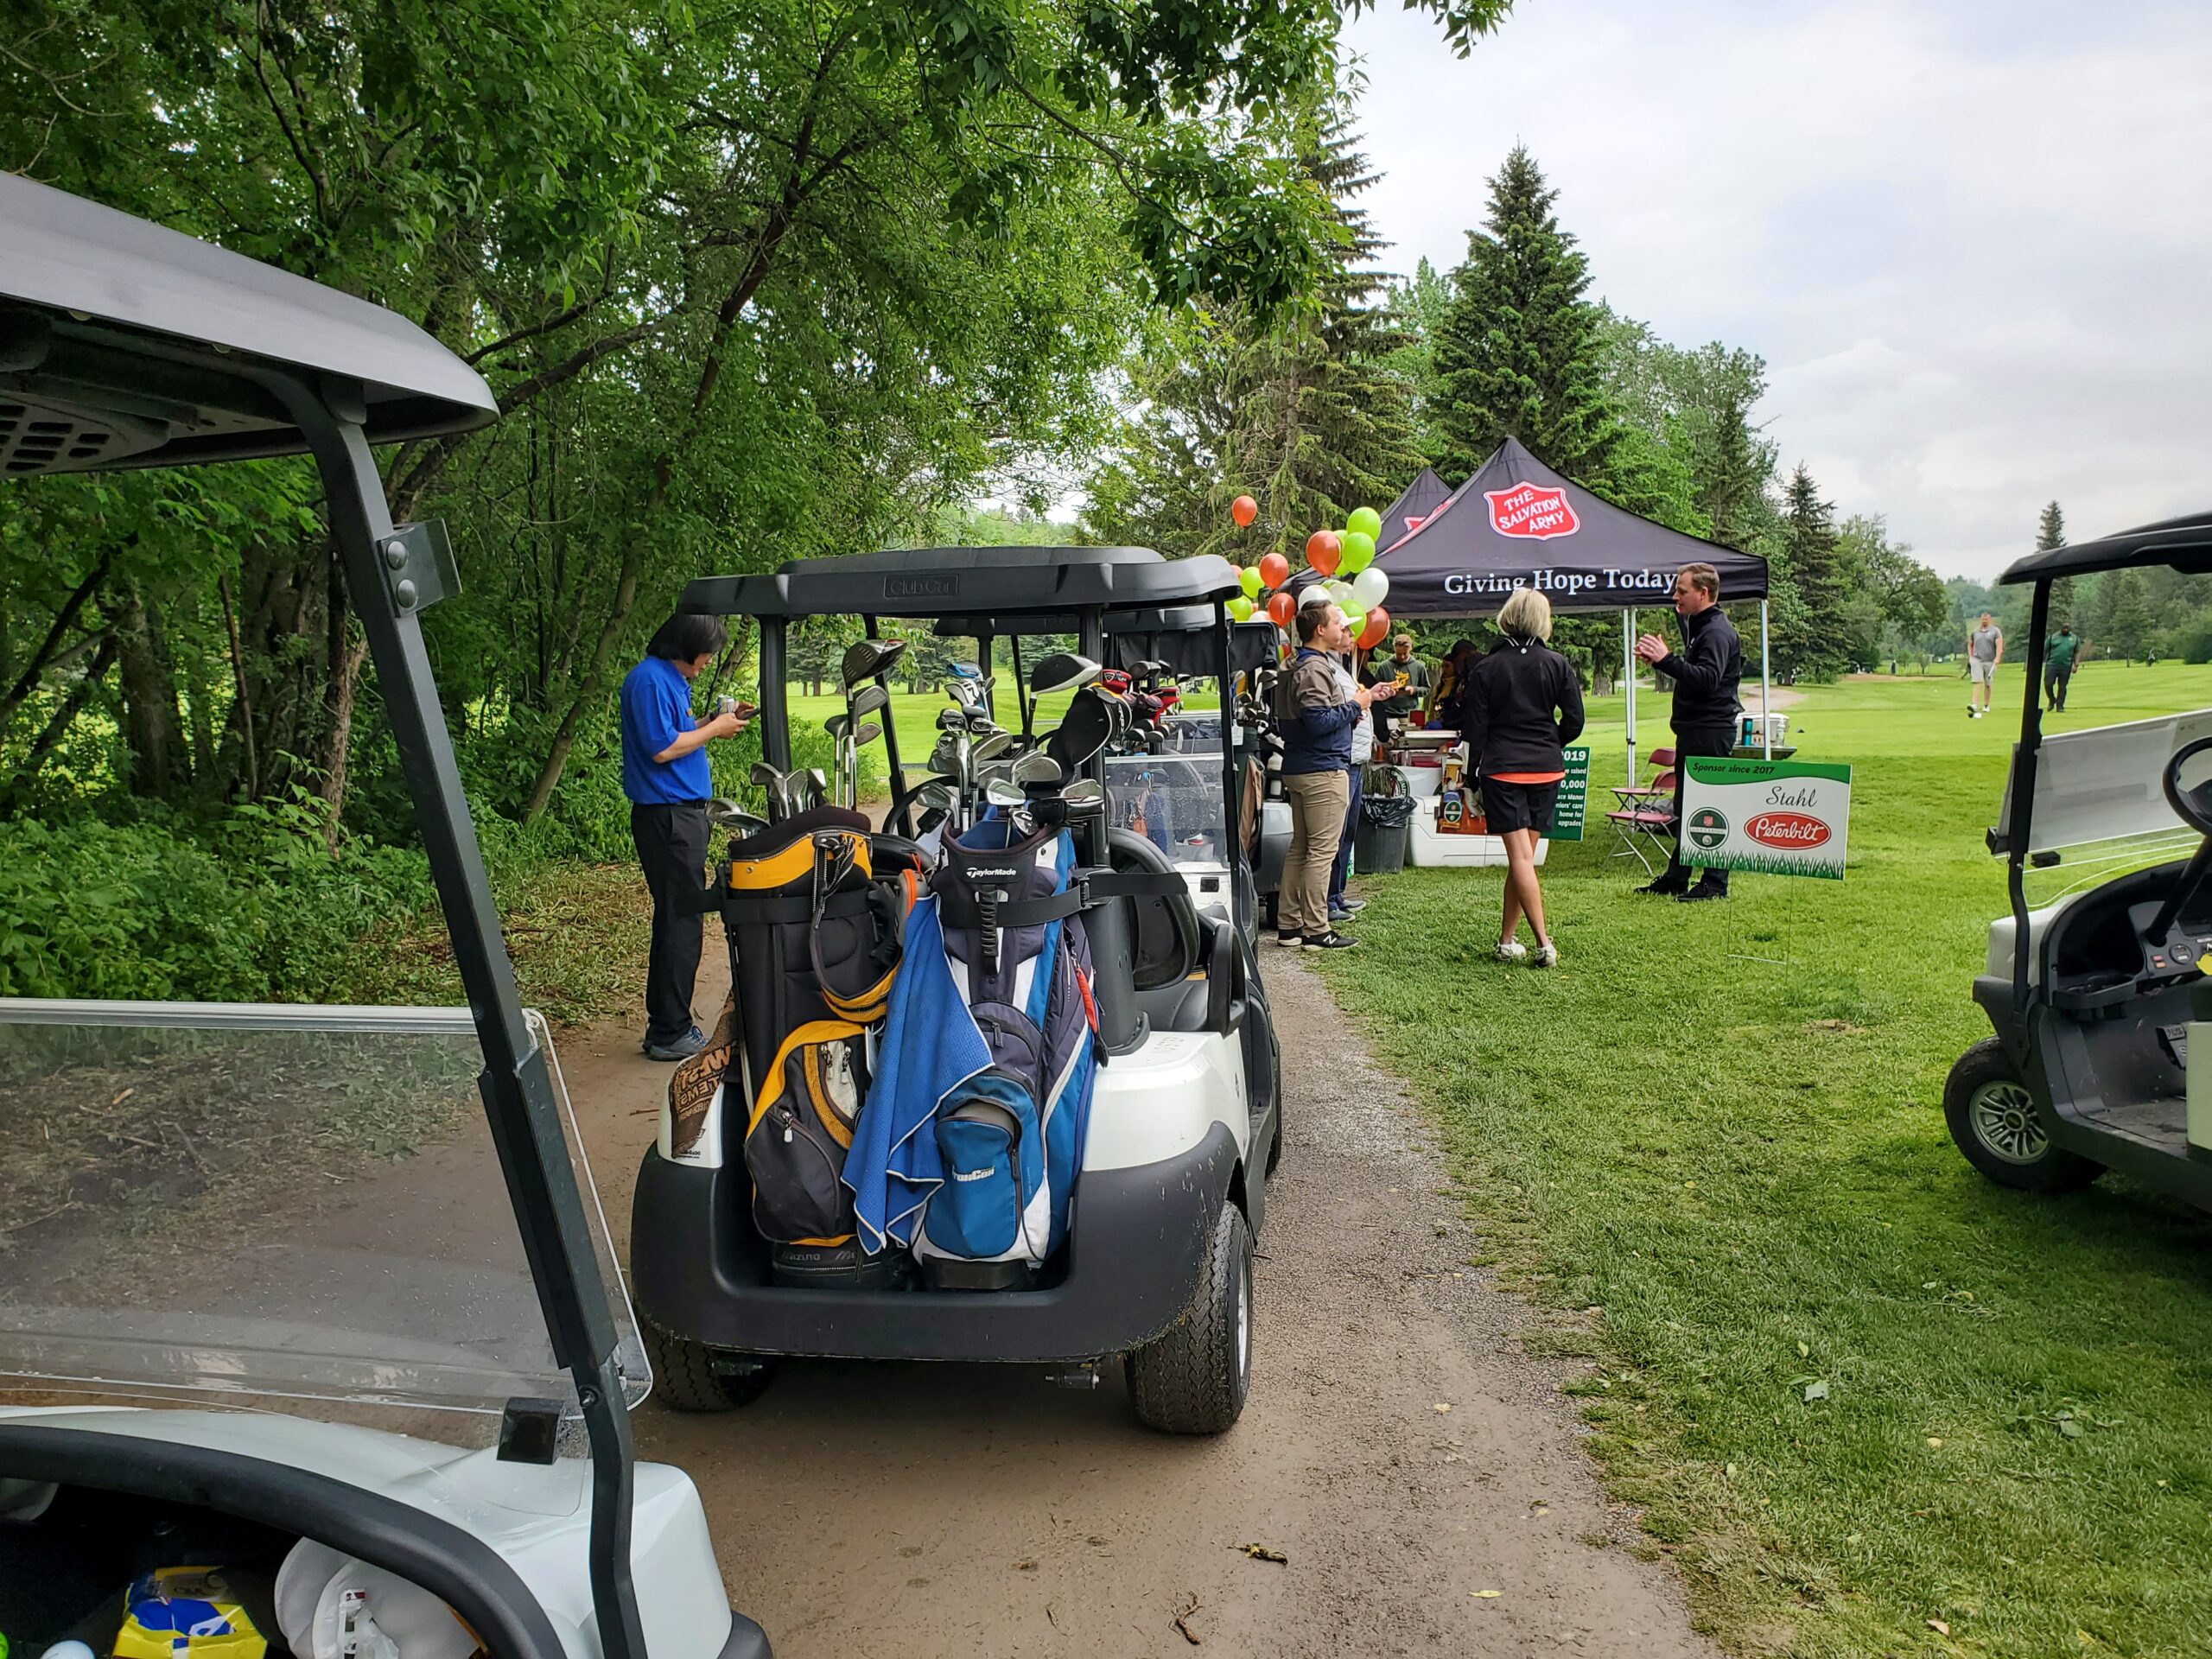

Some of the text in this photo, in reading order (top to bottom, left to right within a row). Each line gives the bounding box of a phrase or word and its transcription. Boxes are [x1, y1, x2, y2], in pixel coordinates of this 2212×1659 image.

[1504, 489, 1534, 512] THE
[1499, 496, 1561, 530] SALVATION
[1529, 512, 1565, 533] ARMY
[1444, 568, 1679, 595] Giving Hope Today
[1561, 750, 1586, 761] 019
[1693, 762, 1775, 775] Sponsor since 2017
[1560, 779, 1586, 790] 0,000
[1765, 785, 1818, 807] Stahl
[1755, 817, 1825, 841] Peterbilt
[966, 867, 1017, 879] TaylorMade
